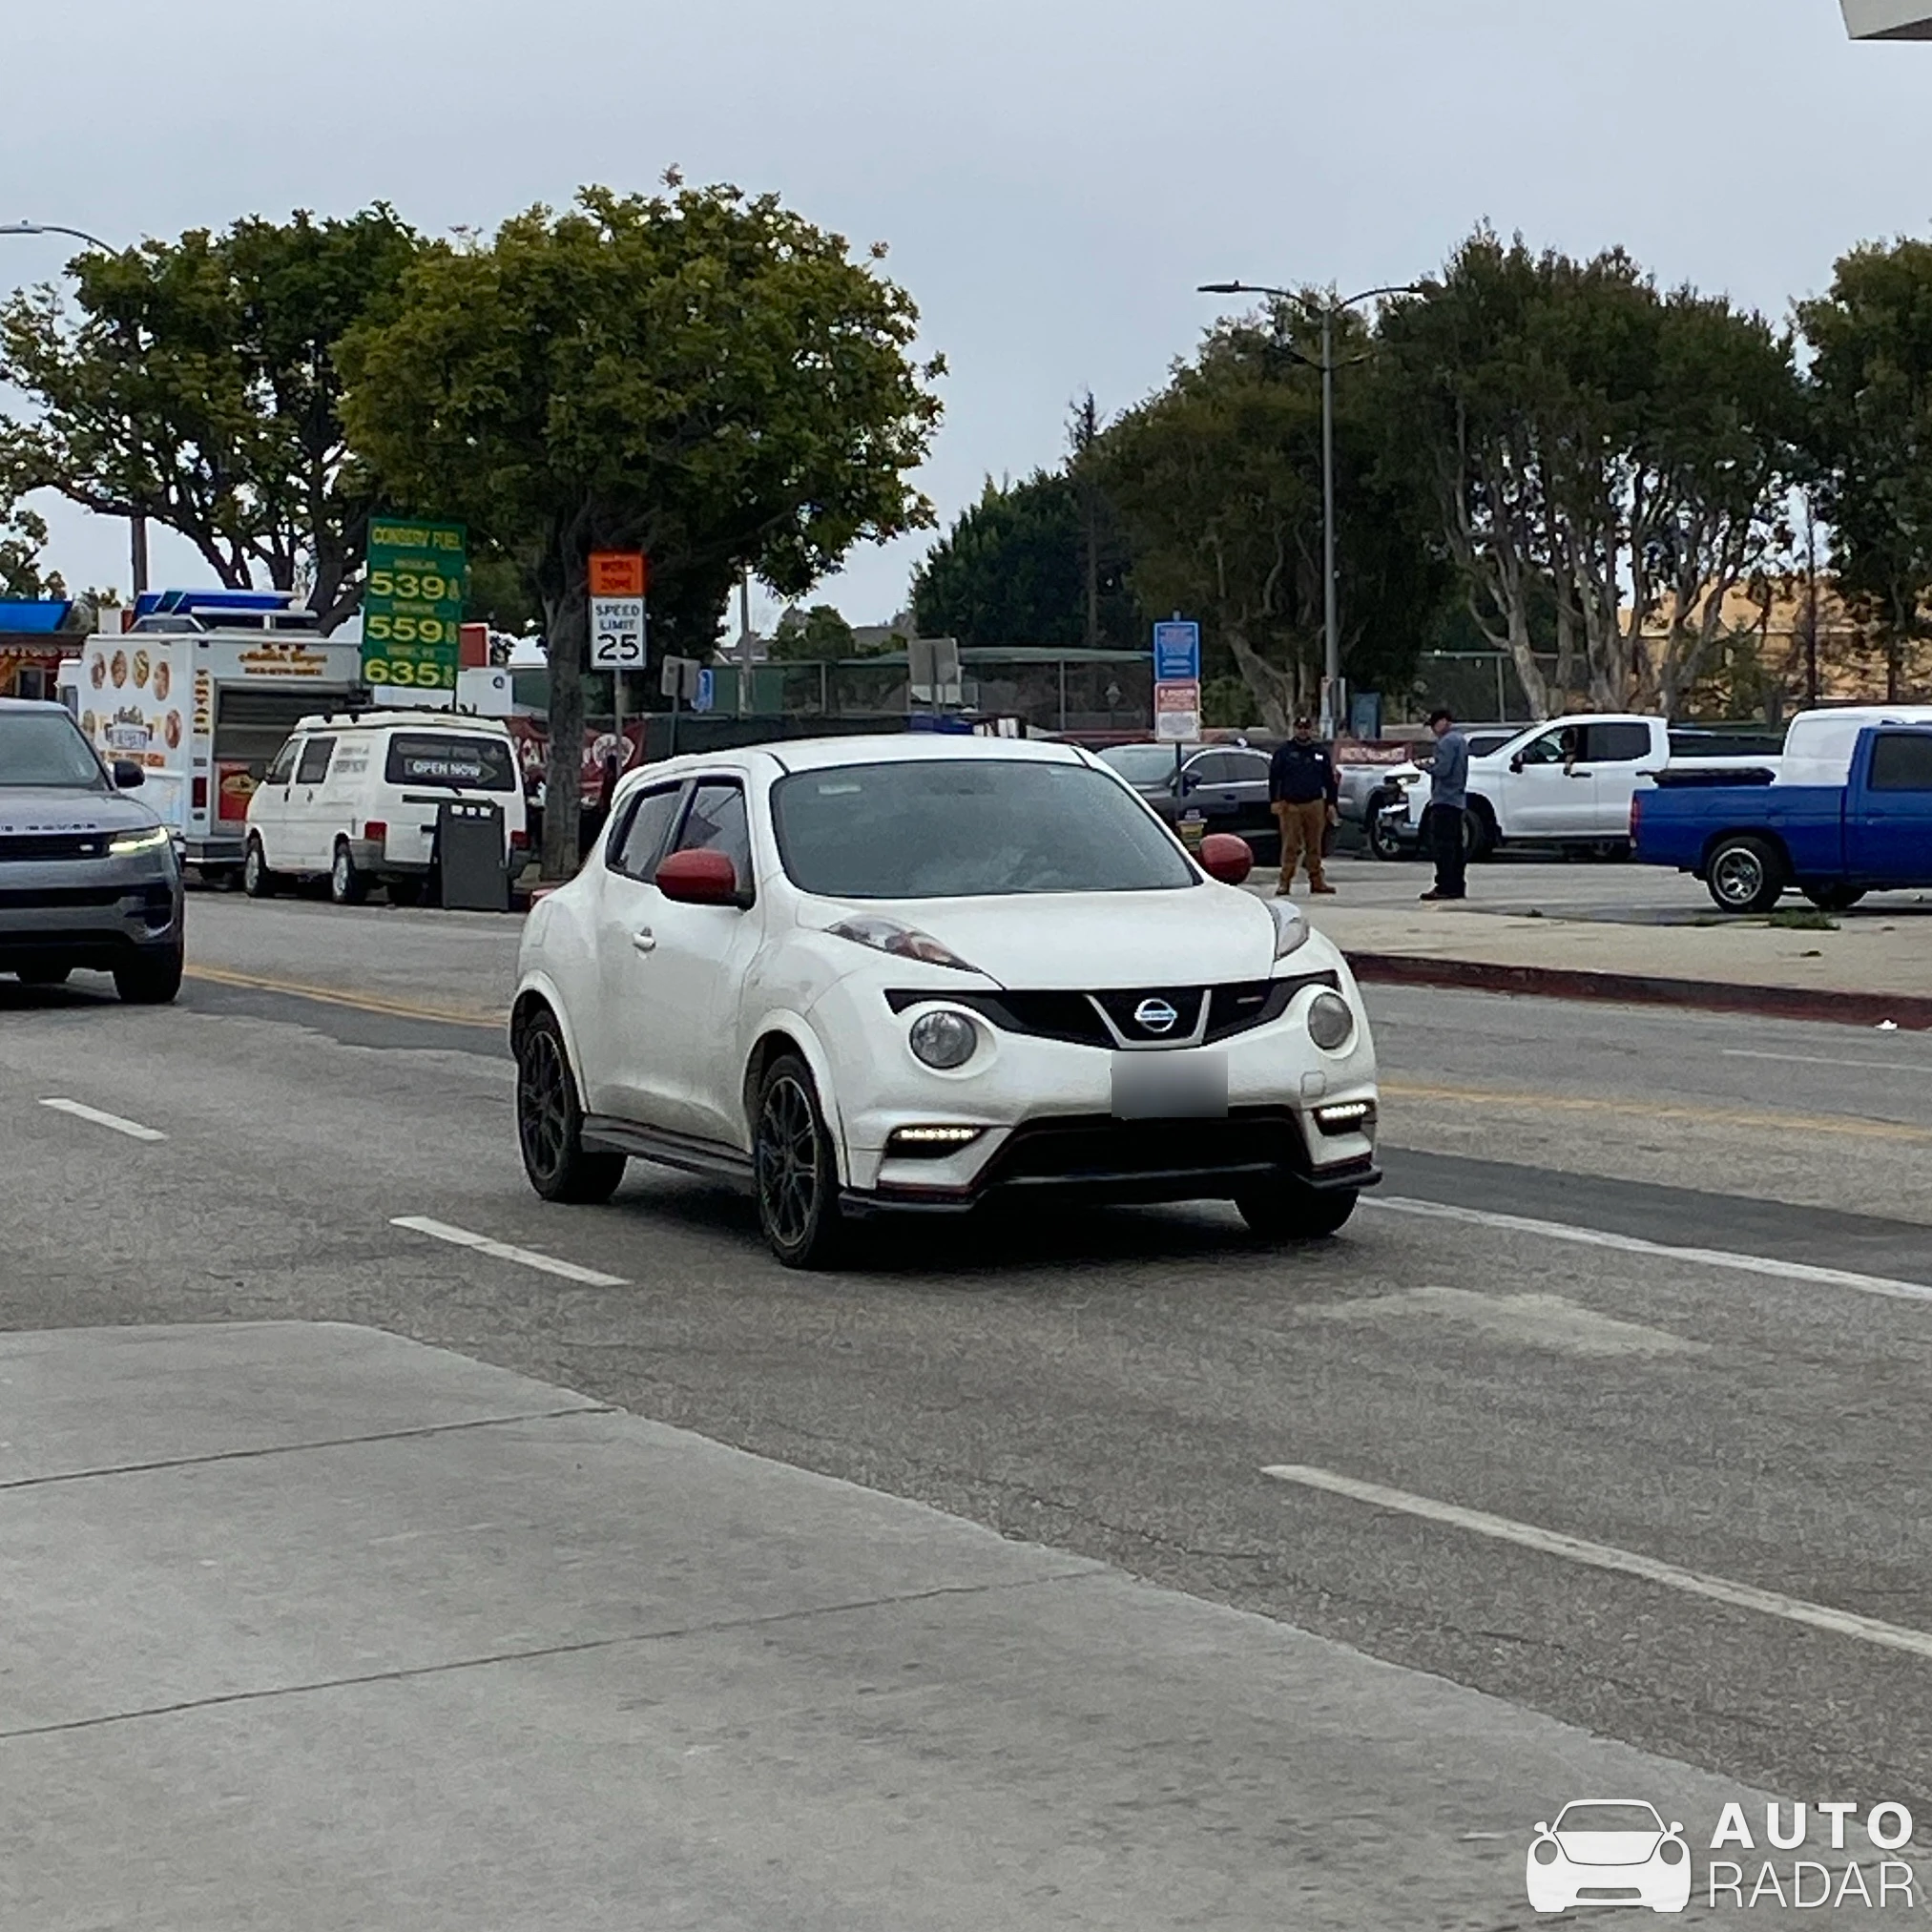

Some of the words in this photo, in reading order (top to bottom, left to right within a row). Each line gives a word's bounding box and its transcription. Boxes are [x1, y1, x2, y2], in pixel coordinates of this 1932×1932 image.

[368, 571, 446, 601] 539
[594, 604, 640, 616] SPEED
[365, 615, 444, 644] 559
[599, 618, 635, 631] LIMIT
[597, 634, 640, 660] 25
[364, 658, 442, 686] 635
[412, 760, 447, 775] OPEN
[450, 763, 481, 777] NOW
